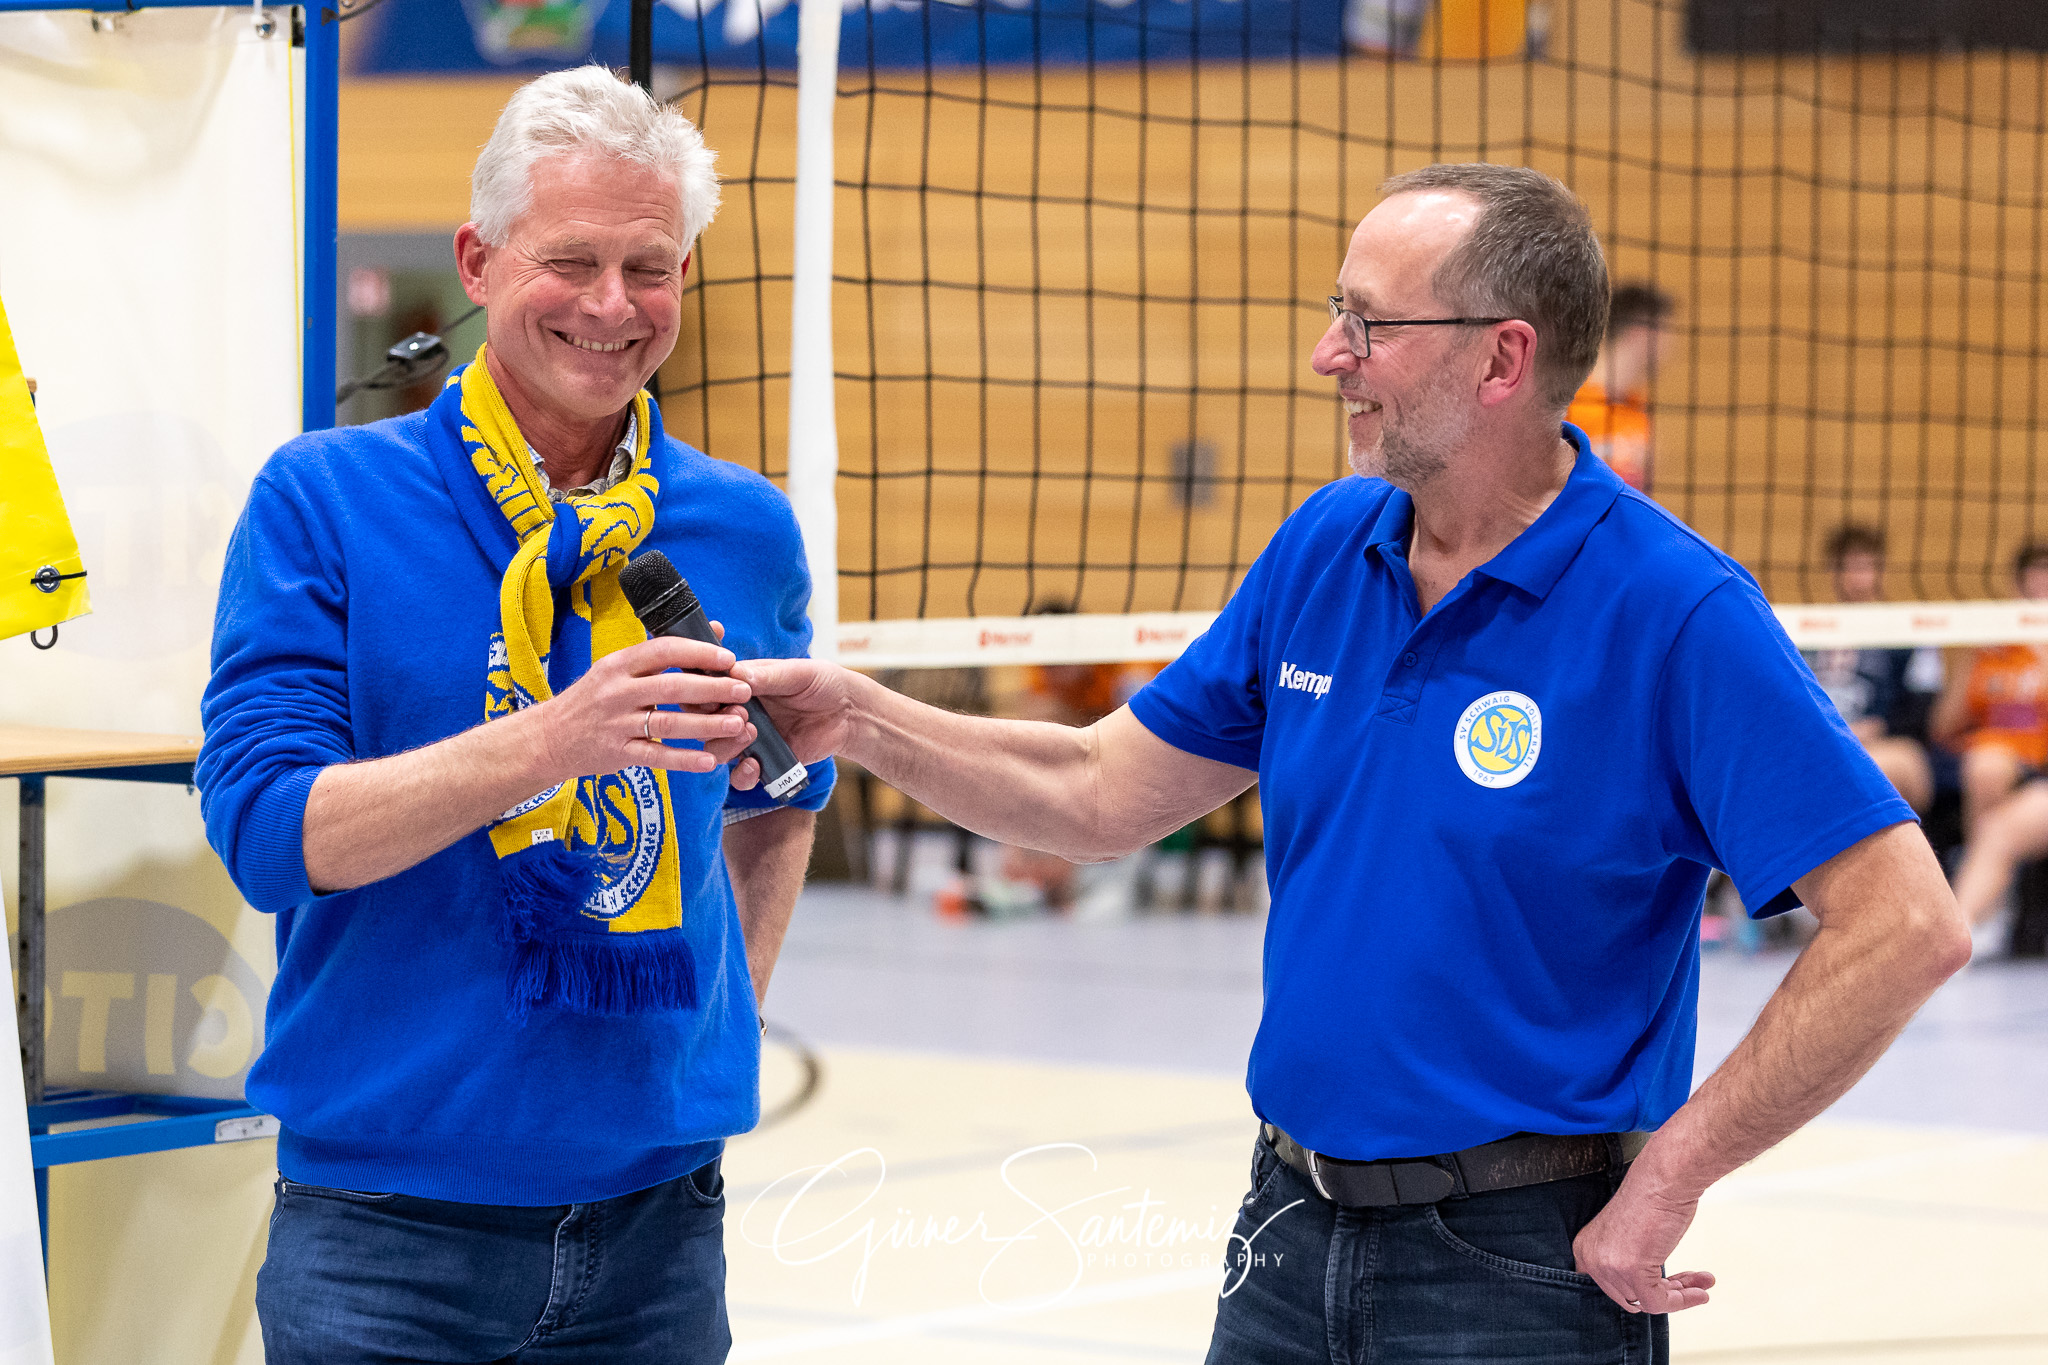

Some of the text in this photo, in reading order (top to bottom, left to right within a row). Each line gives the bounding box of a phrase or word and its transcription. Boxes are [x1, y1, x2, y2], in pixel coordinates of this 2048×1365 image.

[1459, 695, 1510, 740] SV SCHWAIG
[1524, 702, 1539, 768] VOLLEYBALL
[777, 768, 803, 789] HM 13
[1472, 769, 1496, 784] 1967
